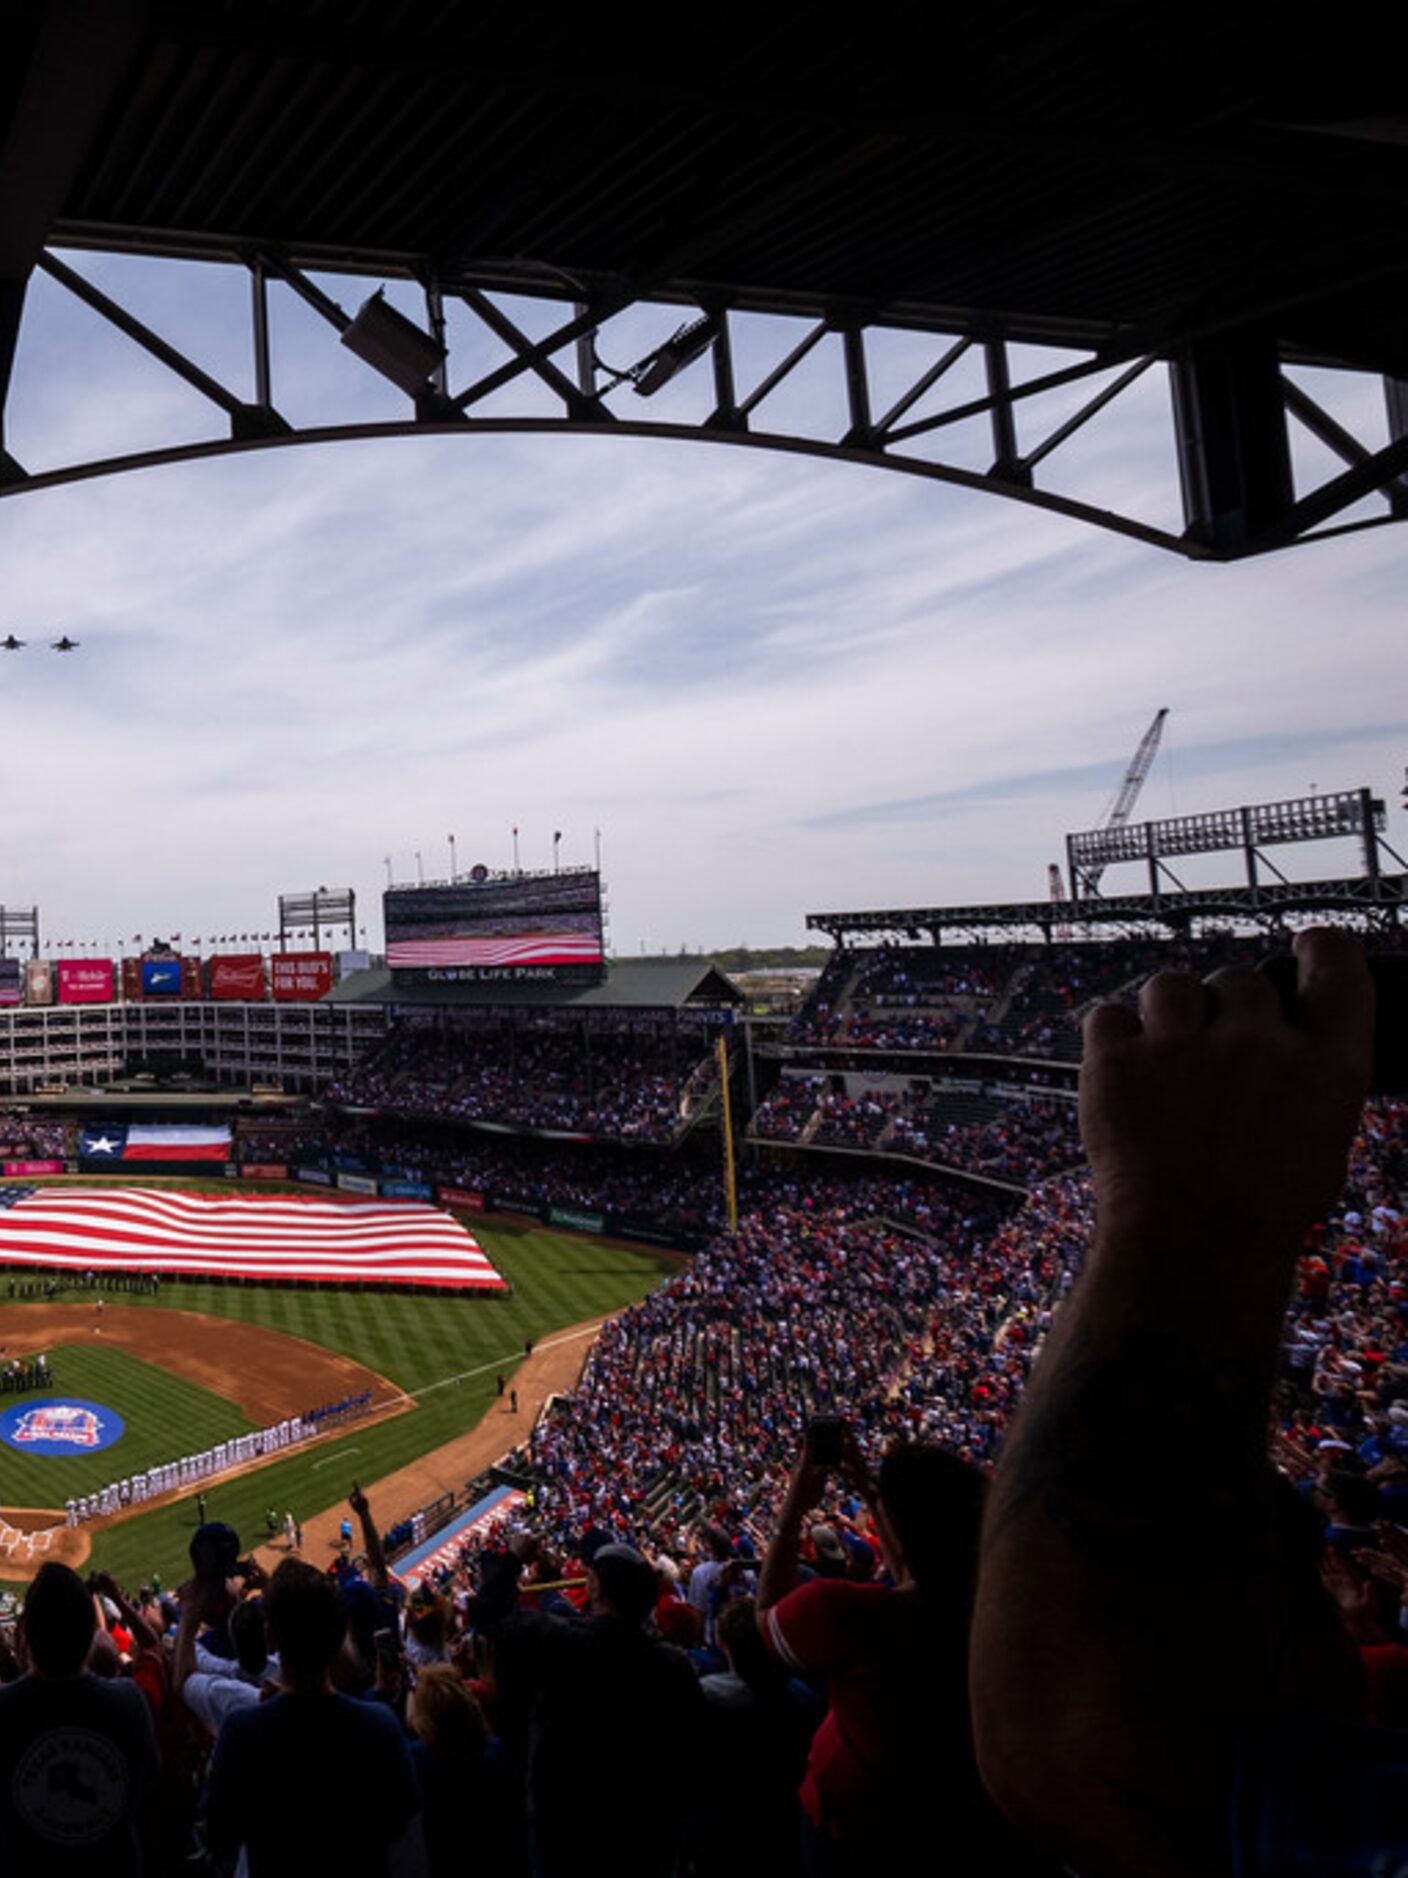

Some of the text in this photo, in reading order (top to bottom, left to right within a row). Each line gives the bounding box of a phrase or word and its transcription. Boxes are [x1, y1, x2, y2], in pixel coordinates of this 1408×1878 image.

[275, 961, 294, 974] THIS
[480, 967, 511, 980] LIFE
[516, 966, 556, 979] PARK
[275, 976, 293, 990] FOR
